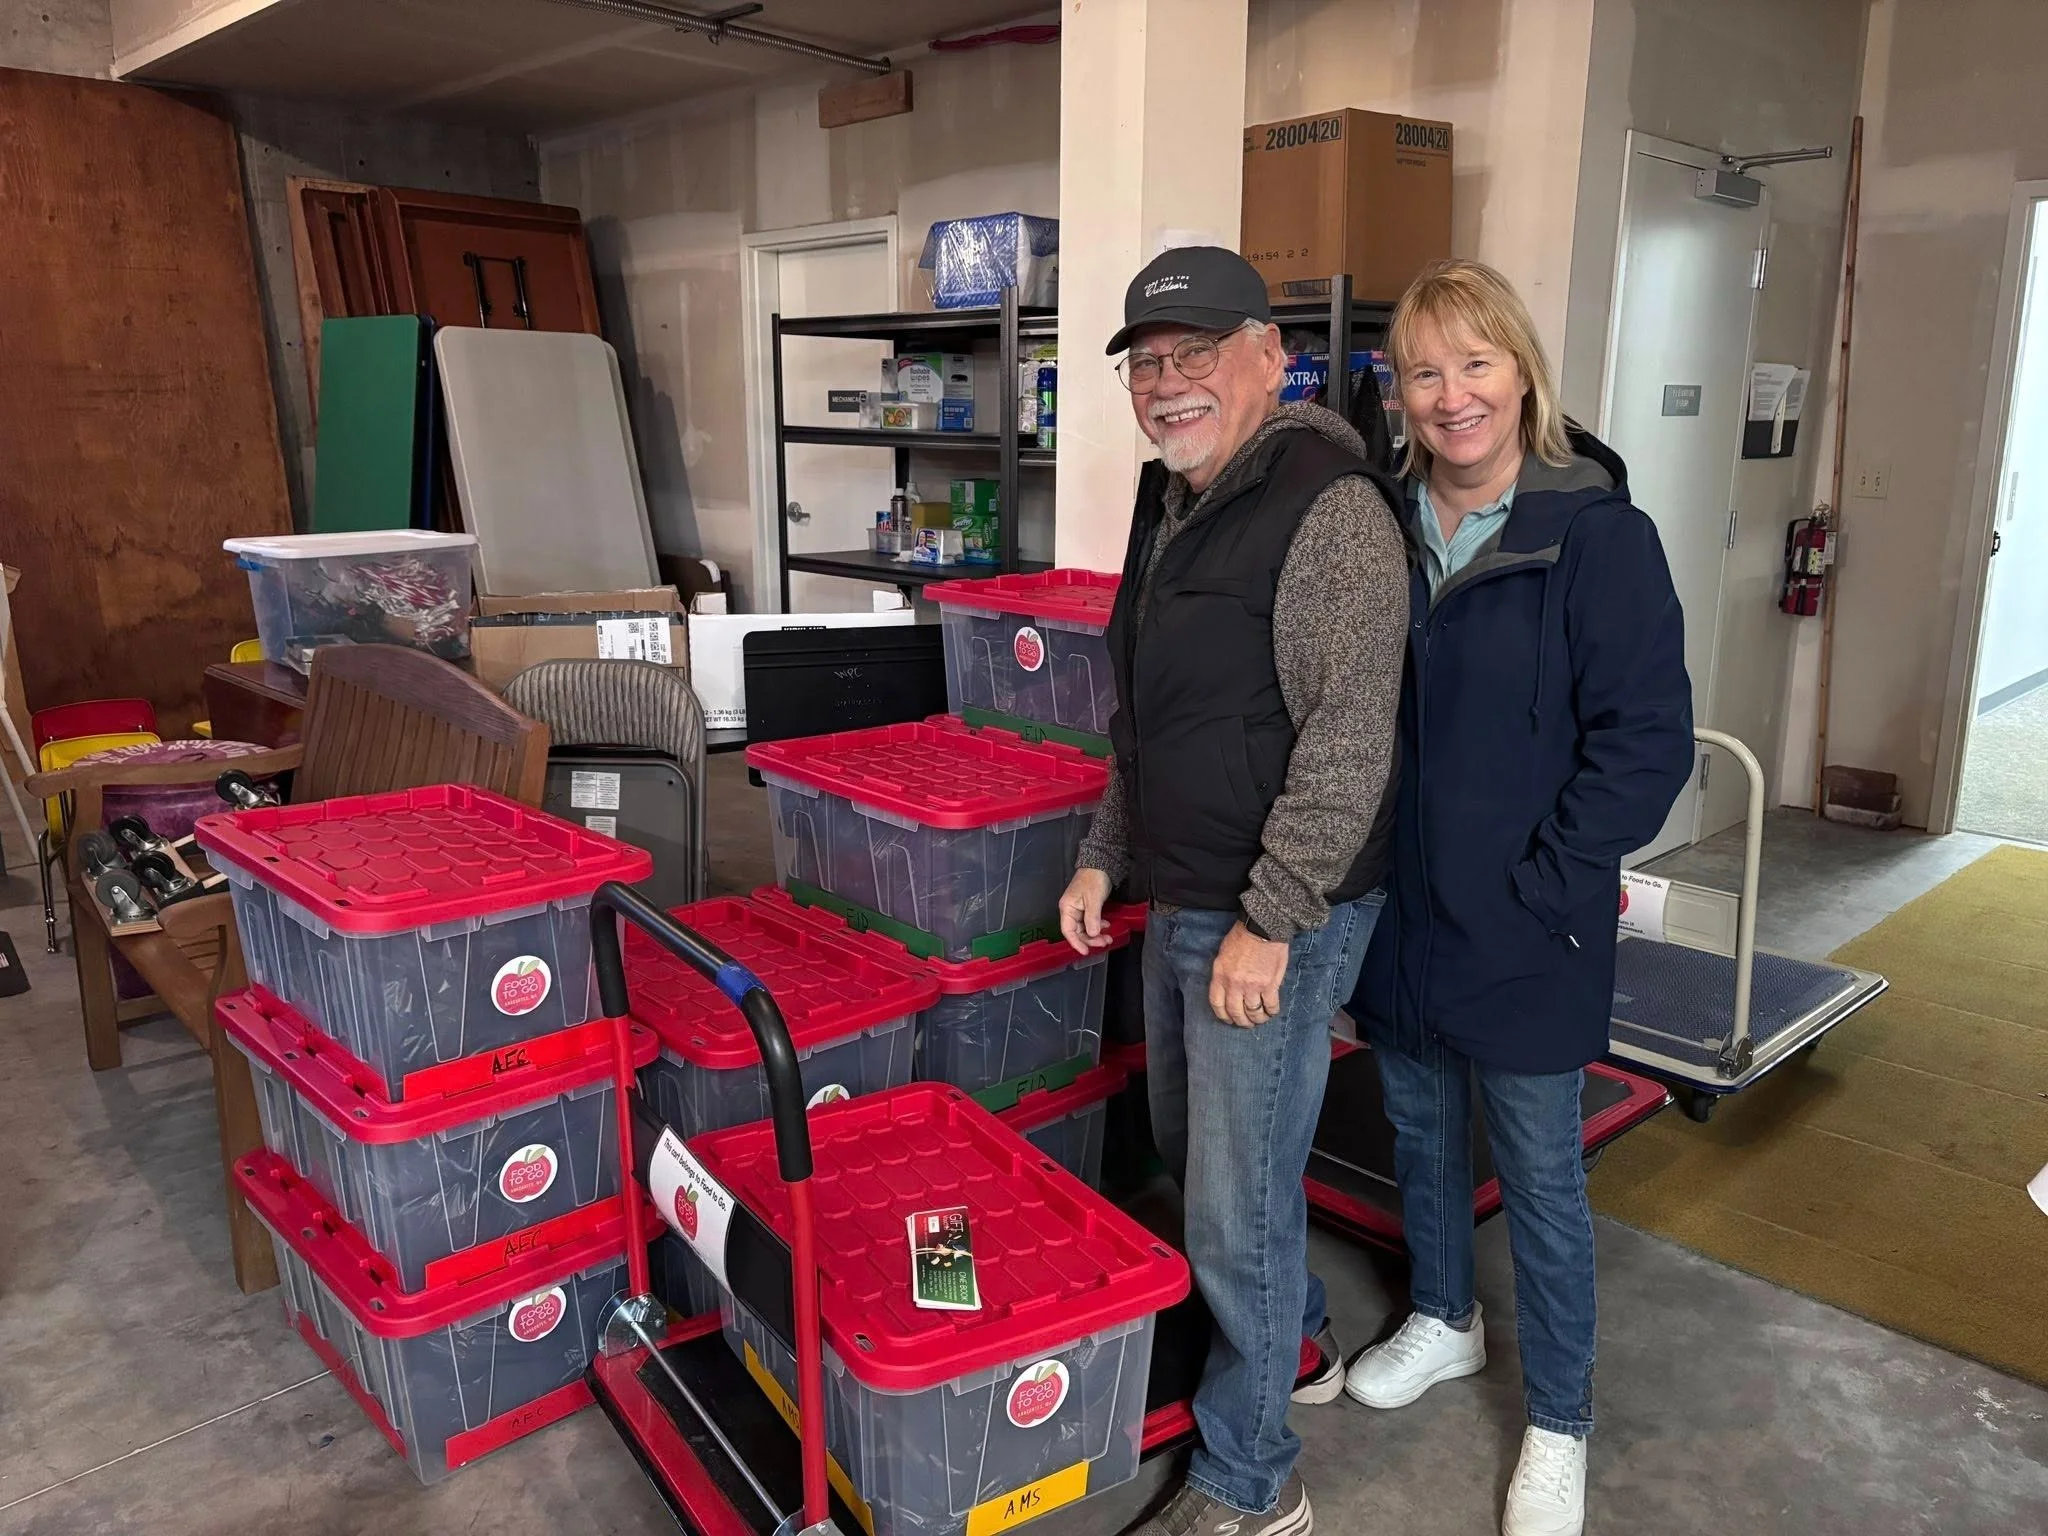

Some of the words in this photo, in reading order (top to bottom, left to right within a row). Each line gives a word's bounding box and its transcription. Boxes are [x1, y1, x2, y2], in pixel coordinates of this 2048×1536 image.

[1628, 875, 1645, 885] Food
[502, 988, 518, 1000] TO
[521, 983, 539, 994] GO
[504, 976, 536, 991] FOOD
[508, 1176, 524, 1187] TO
[527, 1169, 544, 1181] GO
[511, 1163, 542, 1179] FOOD
[664, 1137, 673, 1152] This
[671, 1149, 681, 1161] cart
[679, 1154, 696, 1178] belongs
[694, 1173, 701, 1184] to
[700, 1178, 714, 1196] Food
[712, 1191, 718, 1202] to
[949, 1213, 964, 1232] GIFT
[520, 1301, 551, 1322] FOOD
[520, 1317, 535, 1330] TO
[538, 1306, 555, 1320] GO
[1016, 1397, 1032, 1410] TO
[1036, 1389, 1054, 1402] GO
[1019, 1381, 1052, 1400] FOOD
[1003, 1487, 1042, 1519] AMS
